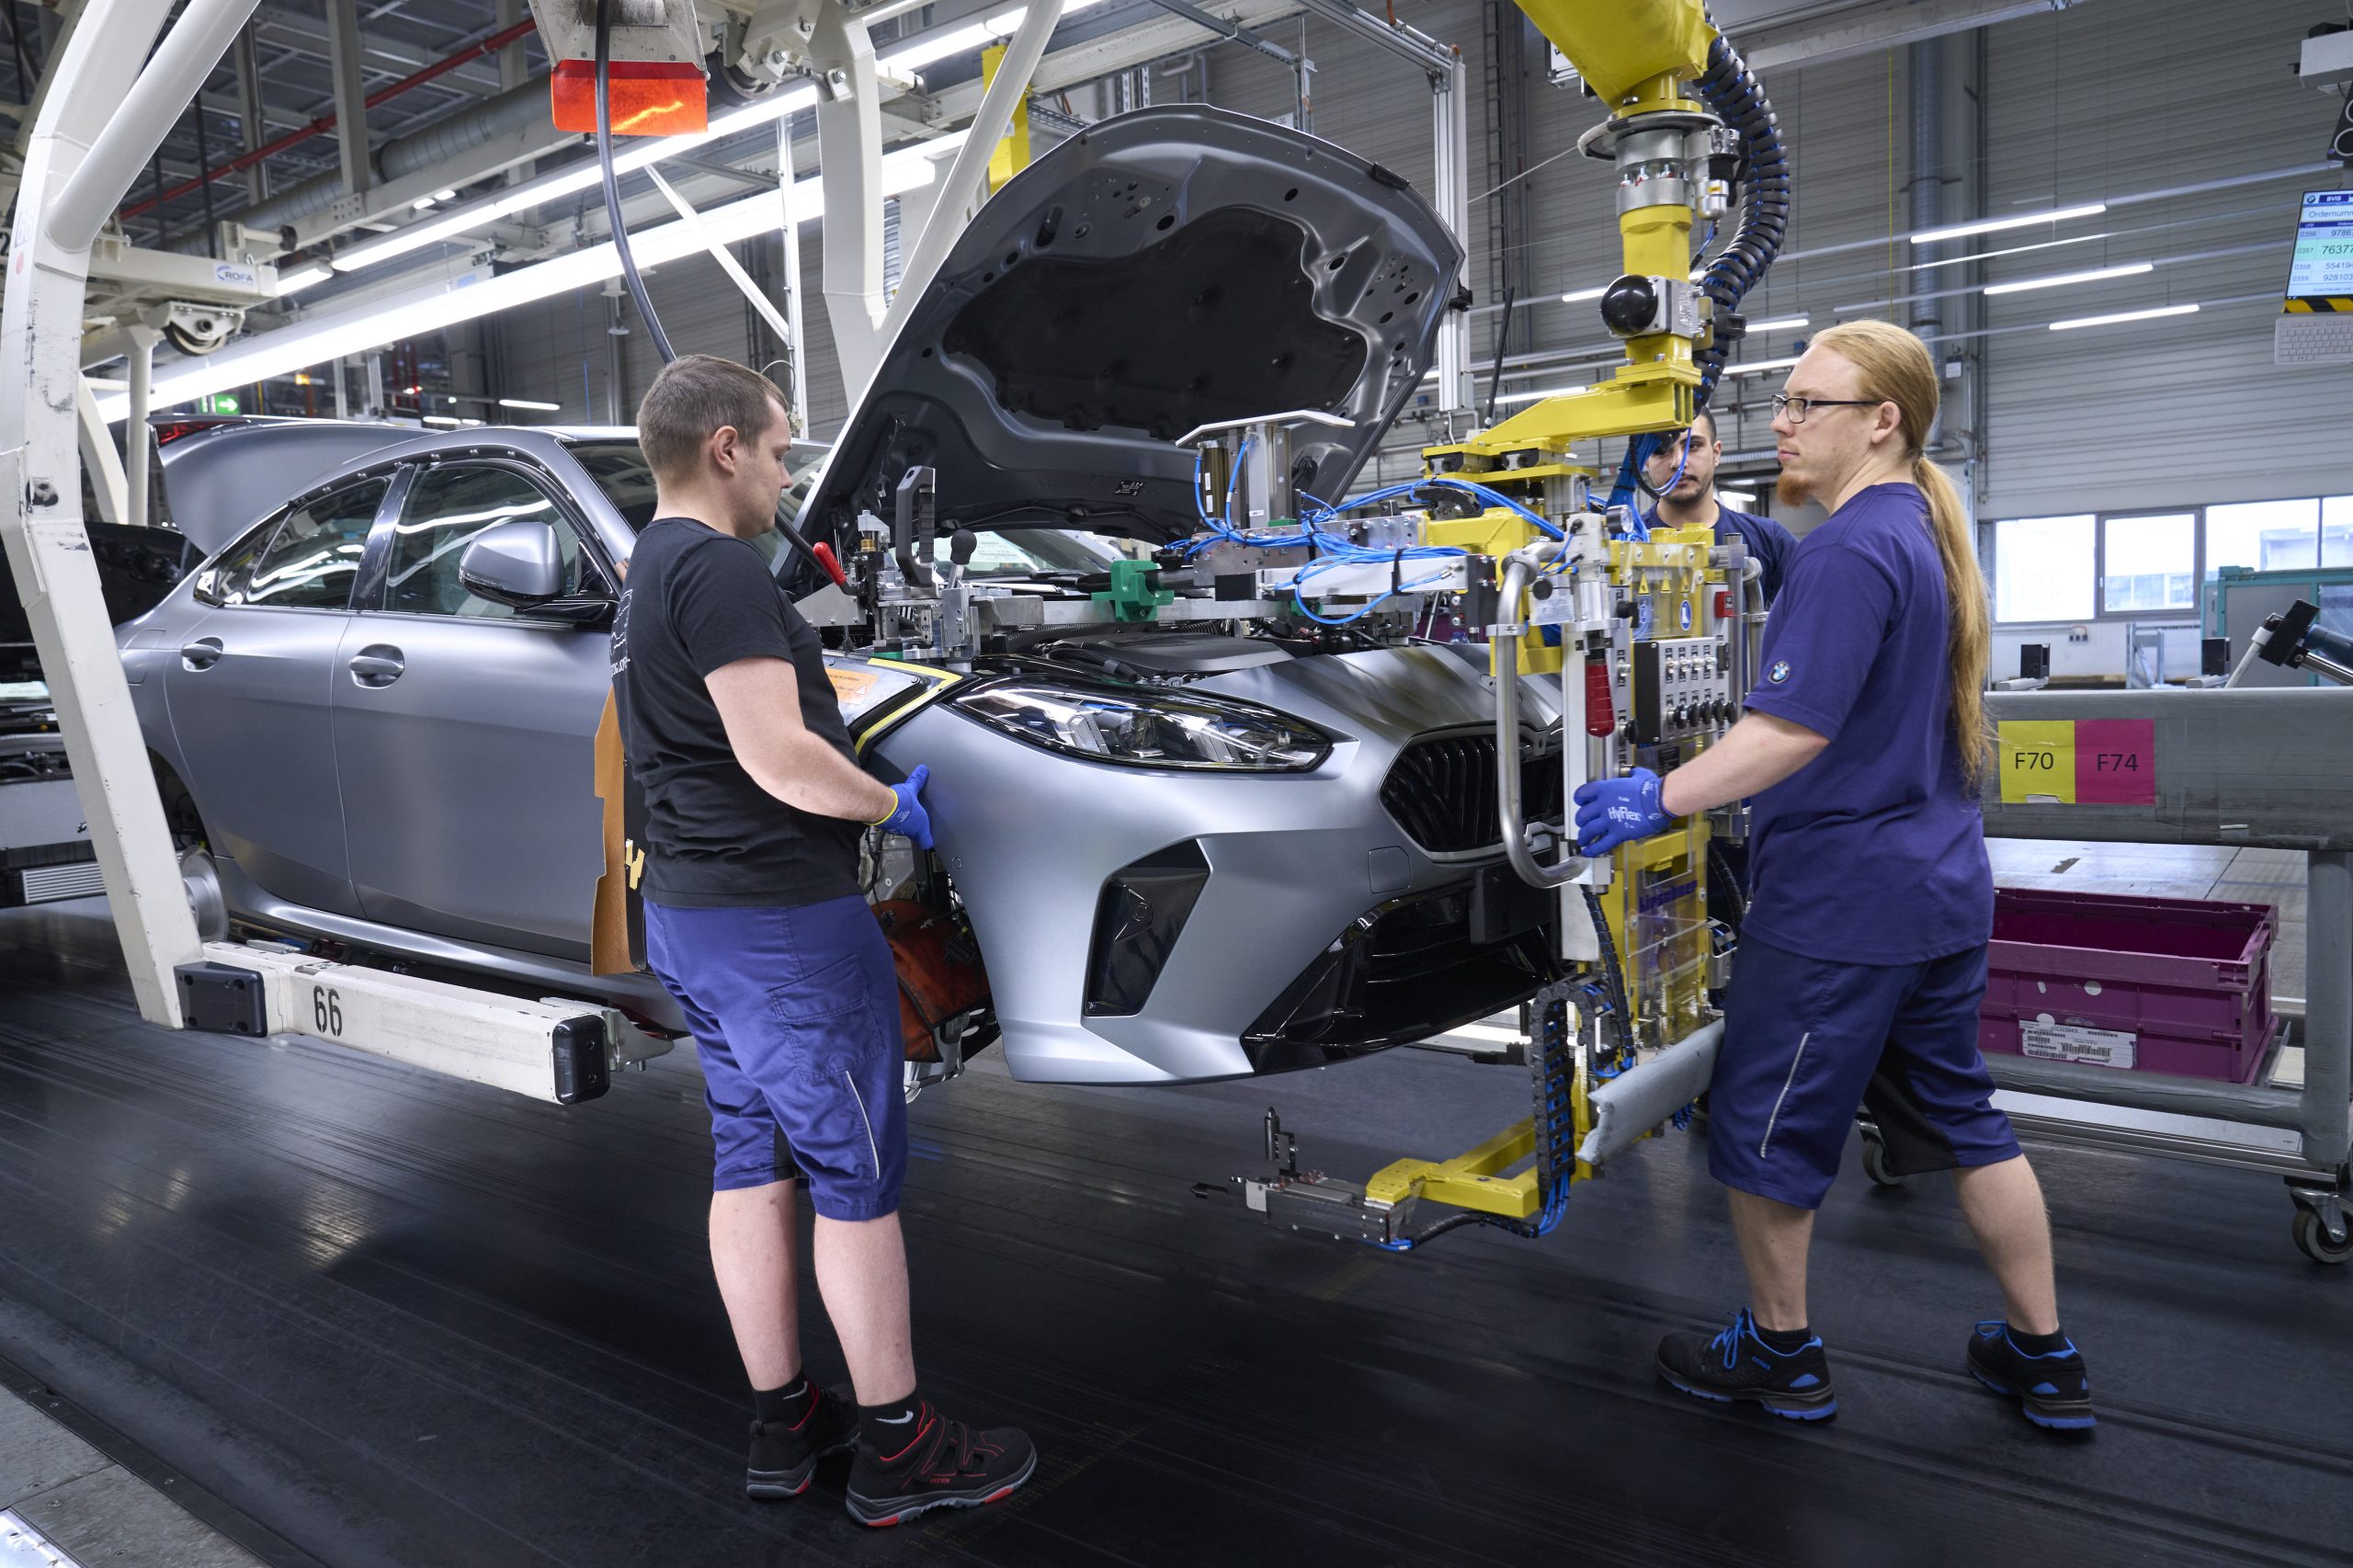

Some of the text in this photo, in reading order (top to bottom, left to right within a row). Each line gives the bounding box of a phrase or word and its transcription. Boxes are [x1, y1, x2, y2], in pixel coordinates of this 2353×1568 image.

[2331, 229, 2353, 237] 9786
[2015, 752, 2139, 771] F70 F74
[1608, 806, 1641, 822] HyFlex
[313, 985, 343, 1038] 66
